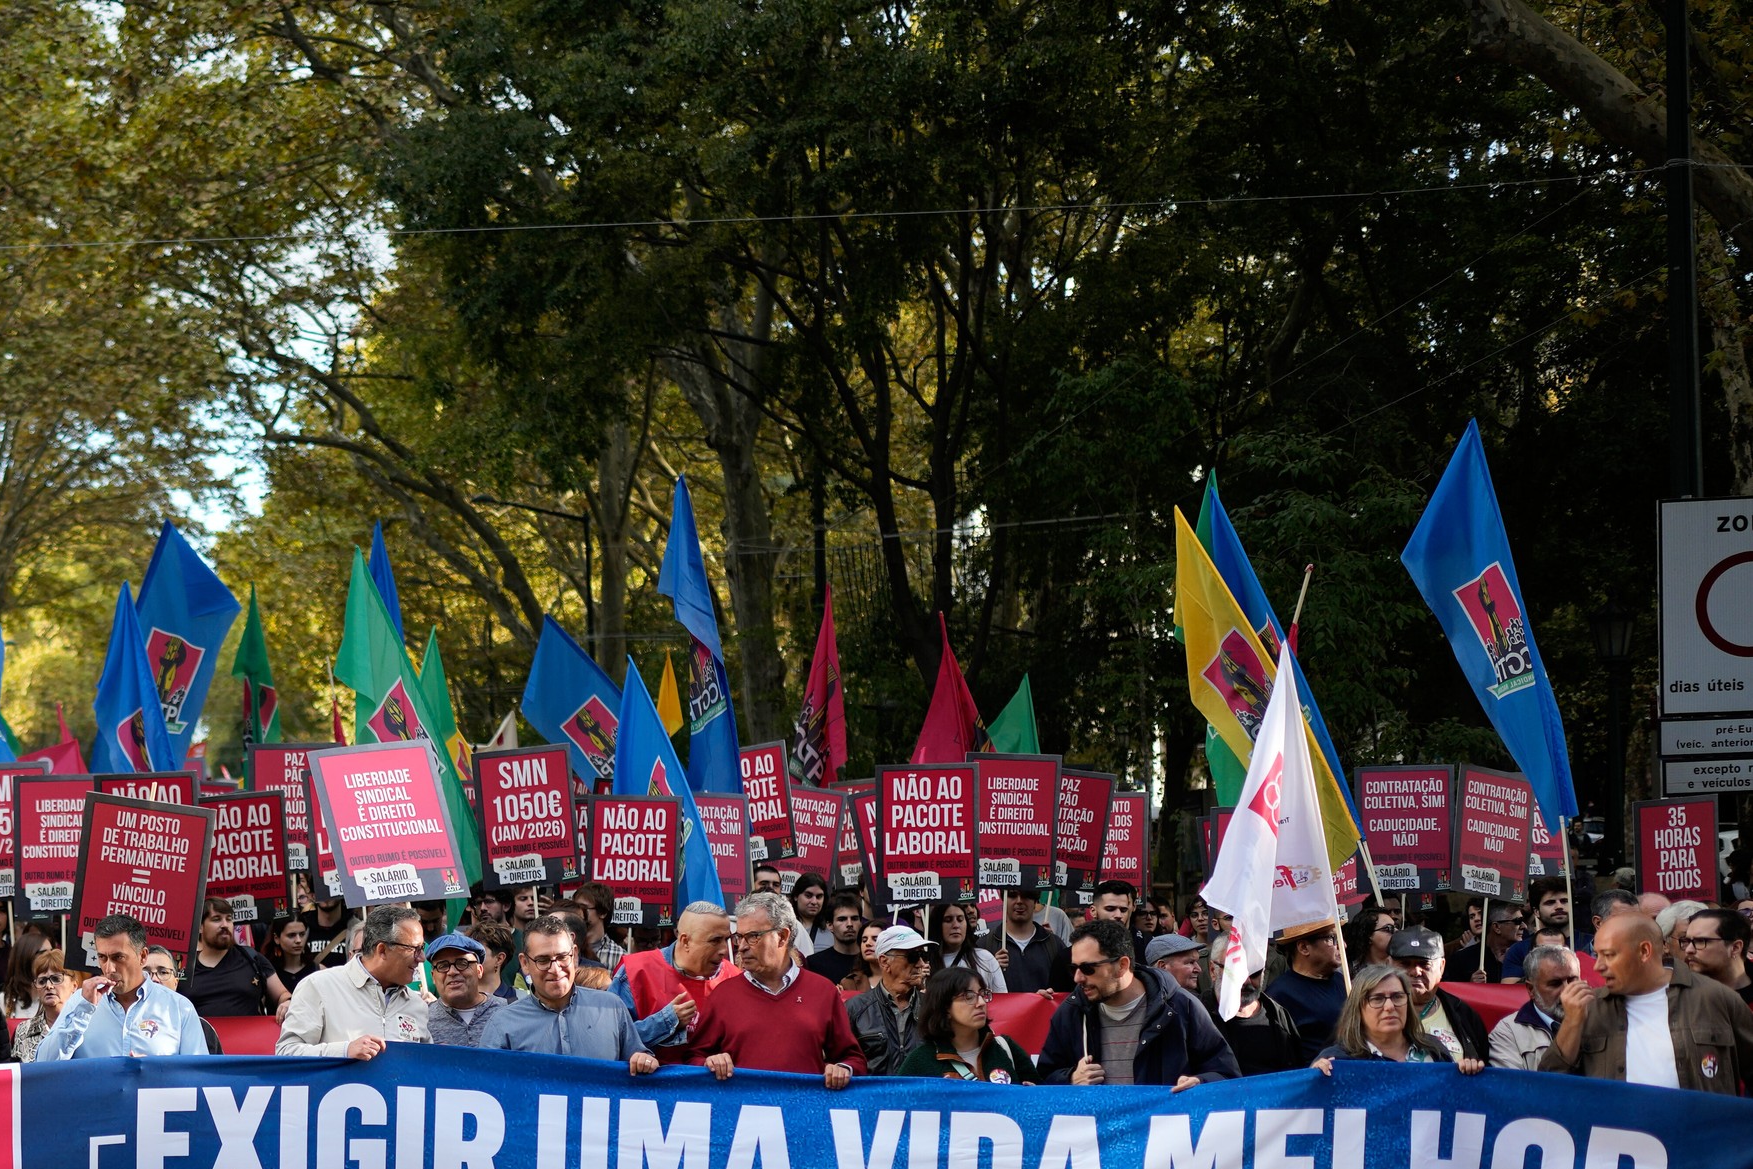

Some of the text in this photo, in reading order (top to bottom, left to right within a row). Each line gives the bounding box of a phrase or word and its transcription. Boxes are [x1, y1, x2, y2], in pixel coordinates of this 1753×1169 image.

[1717, 515, 1753, 532] ZO
[1670, 679, 1744, 692] dias úteis
[1716, 725, 1753, 735] pré-Eu
[1677, 739, 1704, 750] (veíc.
[344, 769, 412, 789] LIBERDADE
[498, 758, 548, 789] SMN
[1694, 765, 1741, 776] excepto
[893, 773, 962, 800] NÃO AO
[988, 778, 1039, 791] LIBERDADE
[1366, 779, 1443, 795] CONTRATAÇÃO
[1702, 777, 1750, 788] veículos
[355, 787, 411, 806] SINDICAL
[991, 792, 1033, 806] SINDICAL
[1468, 781, 1527, 804] CONTRATAÇÃO
[493, 790, 563, 823] 1050€
[1365, 795, 1445, 811] COLETIVA, SIM!
[1465, 797, 1527, 820] COLETIVA, SIM!
[358, 803, 416, 822] É DIREITO
[603, 804, 667, 830] NÃO AO
[892, 804, 963, 828] PACOTE
[990, 806, 1034, 820] É DIREITO
[1668, 807, 1686, 827] 35
[116, 811, 180, 834] UM POSTO
[340, 819, 443, 842] CONSTITUCIONAL
[979, 821, 1050, 836] ONSTITUCIONAL
[1370, 818, 1441, 834] CADUCIDADE,
[492, 820, 566, 846] (JAN/2026)
[1393, 831, 1418, 847] NÃO!
[1467, 820, 1522, 843] CADUCIDADE,
[1655, 827, 1701, 850] HORAS
[103, 827, 189, 855] DE TRABALHO
[491, 840, 569, 855] OUTRO RUMO É POSSÍVEL!
[601, 833, 666, 856] PACOTE
[886, 830, 970, 856] LABORAL
[1484, 838, 1504, 854] NÃO!
[101, 845, 186, 872] PERMANENTE
[350, 848, 446, 866] OUTRO RUMO É POSSÍVEL!
[505, 859, 535, 871] SALÁRIO
[1660, 847, 1697, 869] PARA
[593, 859, 671, 882] LABORAL
[984, 862, 1012, 872] SALÁRIO
[1379, 867, 1410, 878] SALÁRIO
[370, 869, 409, 884] SALÁRIO
[509, 870, 542, 882] DIREITOS
[900, 876, 932, 886] SALÁRIO
[986, 874, 1018, 884] DIREITOS
[1383, 878, 1416, 888] DIREITOS
[1657, 868, 1702, 891] TODOS
[112, 883, 166, 906] VÍNCULO
[377, 883, 418, 896] DIREITOS
[445, 885, 461, 893] CGTP
[903, 888, 937, 898] DIREITOS
[107, 902, 166, 924] EFECTIVO
